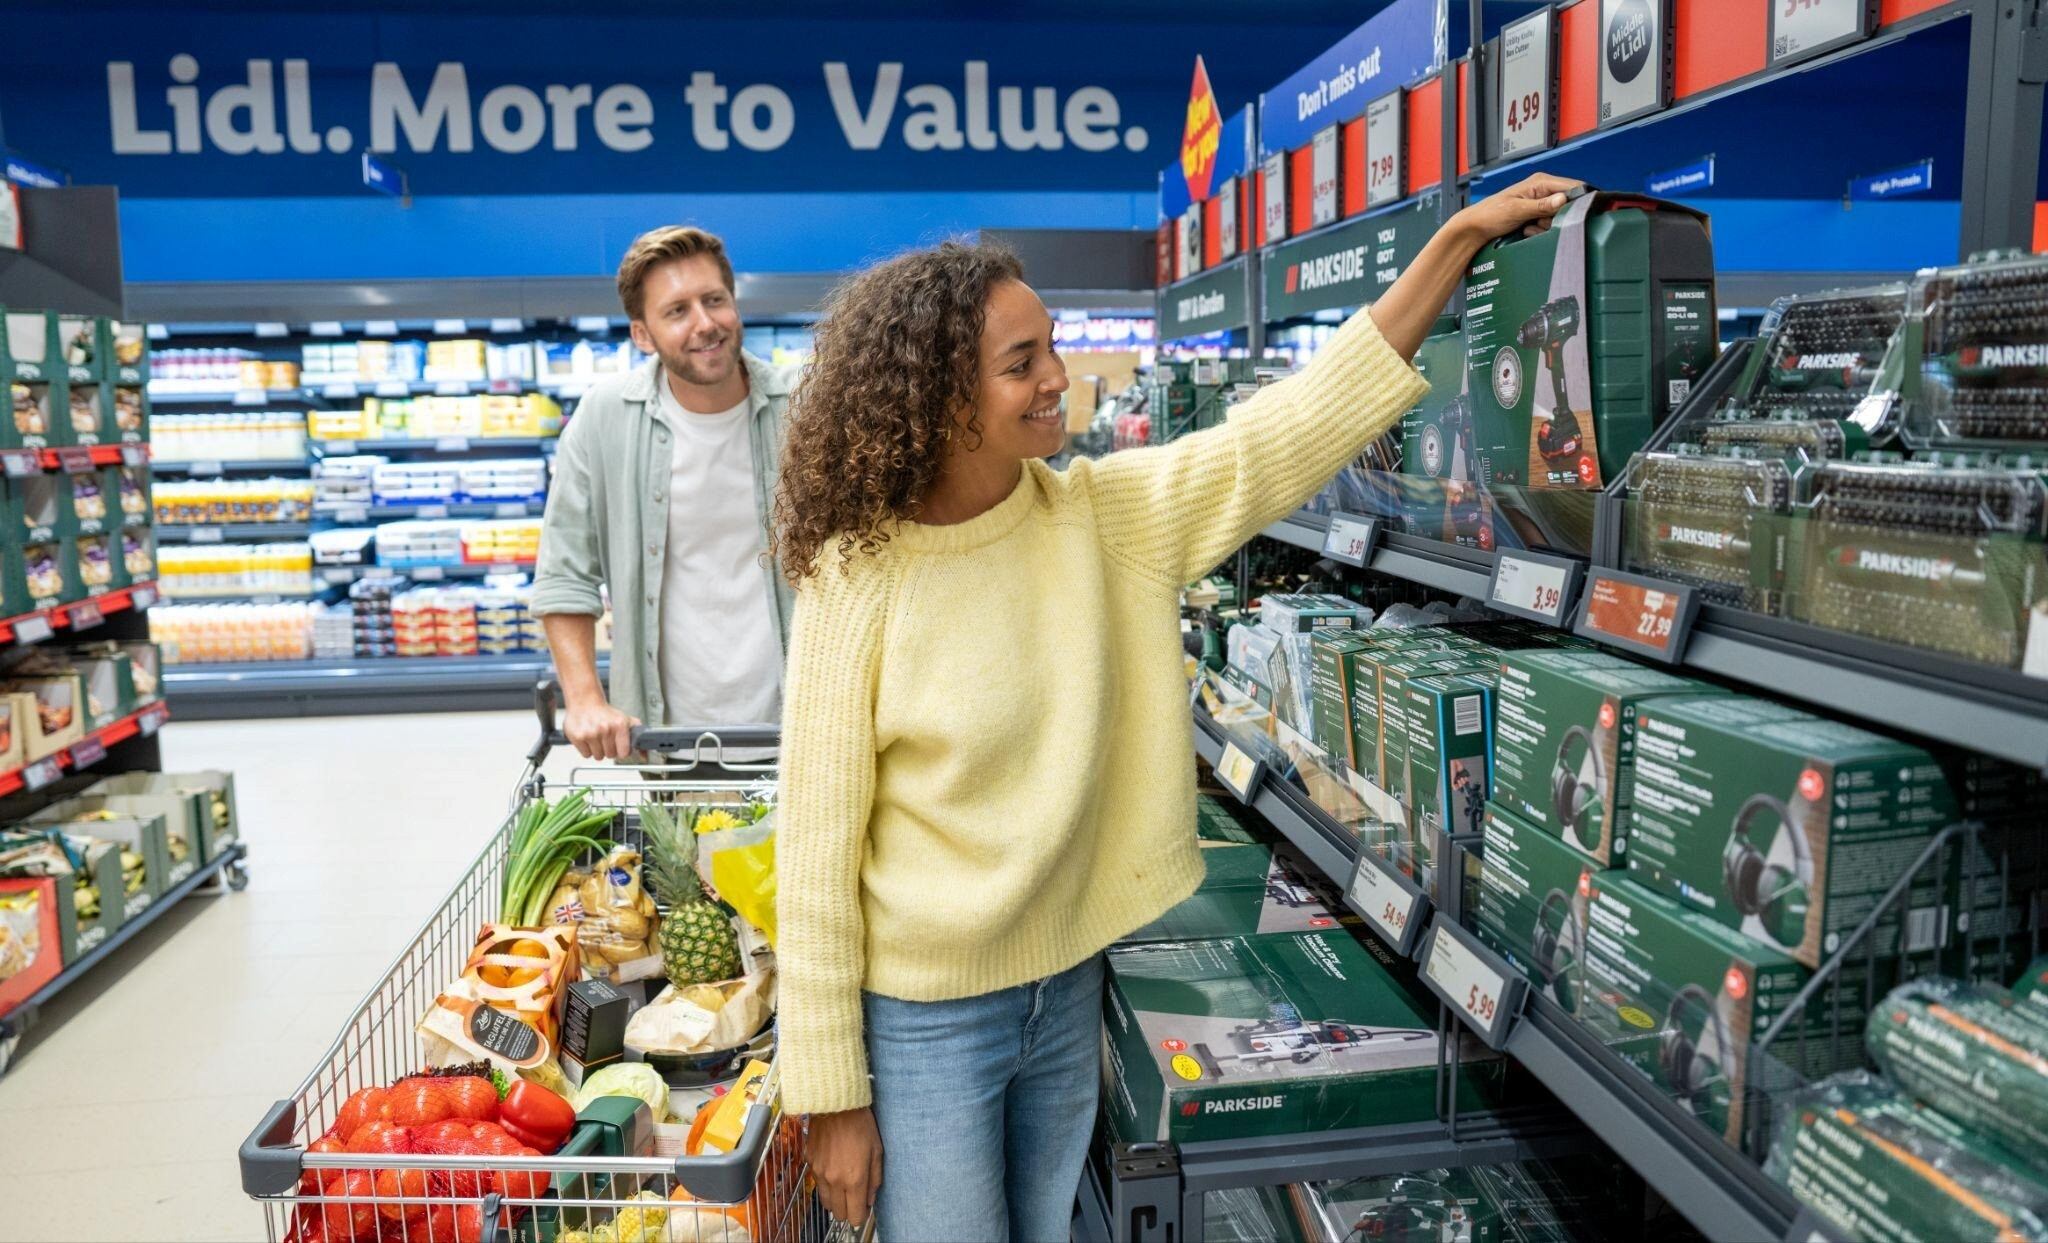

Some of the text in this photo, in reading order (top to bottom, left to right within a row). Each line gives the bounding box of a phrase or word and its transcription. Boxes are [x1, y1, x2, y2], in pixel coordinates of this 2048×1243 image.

[1612, 13, 1644, 48] Middle
[1613, 26, 1646, 62] of Lidl
[1298, 79, 1328, 121] Don't
[1329, 63, 1356, 103] miss
[1358, 46, 1381, 84] out
[107, 54, 1149, 154] Lidl. More to Value.
[1507, 91, 1540, 133] 4.99
[1371, 154, 1393, 187] 7.99
[1377, 228, 1396, 244] YOU
[1301, 246, 1364, 291] PARKSIDE
[1377, 248, 1395, 265] GOT
[1472, 261, 1496, 275] PARKSIDE
[1675, 291, 1706, 299] PARKSIDE
[1797, 352, 1860, 369] PARKSIDE
[1981, 345, 2048, 368] PARKSI
[1671, 526, 1723, 549] PARKSIDE
[1859, 550, 1941, 577] PARKSIDE
[1533, 585, 1559, 610] 3.99
[1637, 611, 1673, 638] 27.99
[1383, 901, 1406, 929] 54.99
[1467, 983, 1495, 1020] 5.99
[1205, 1095, 1284, 1114] PARKSIDE
